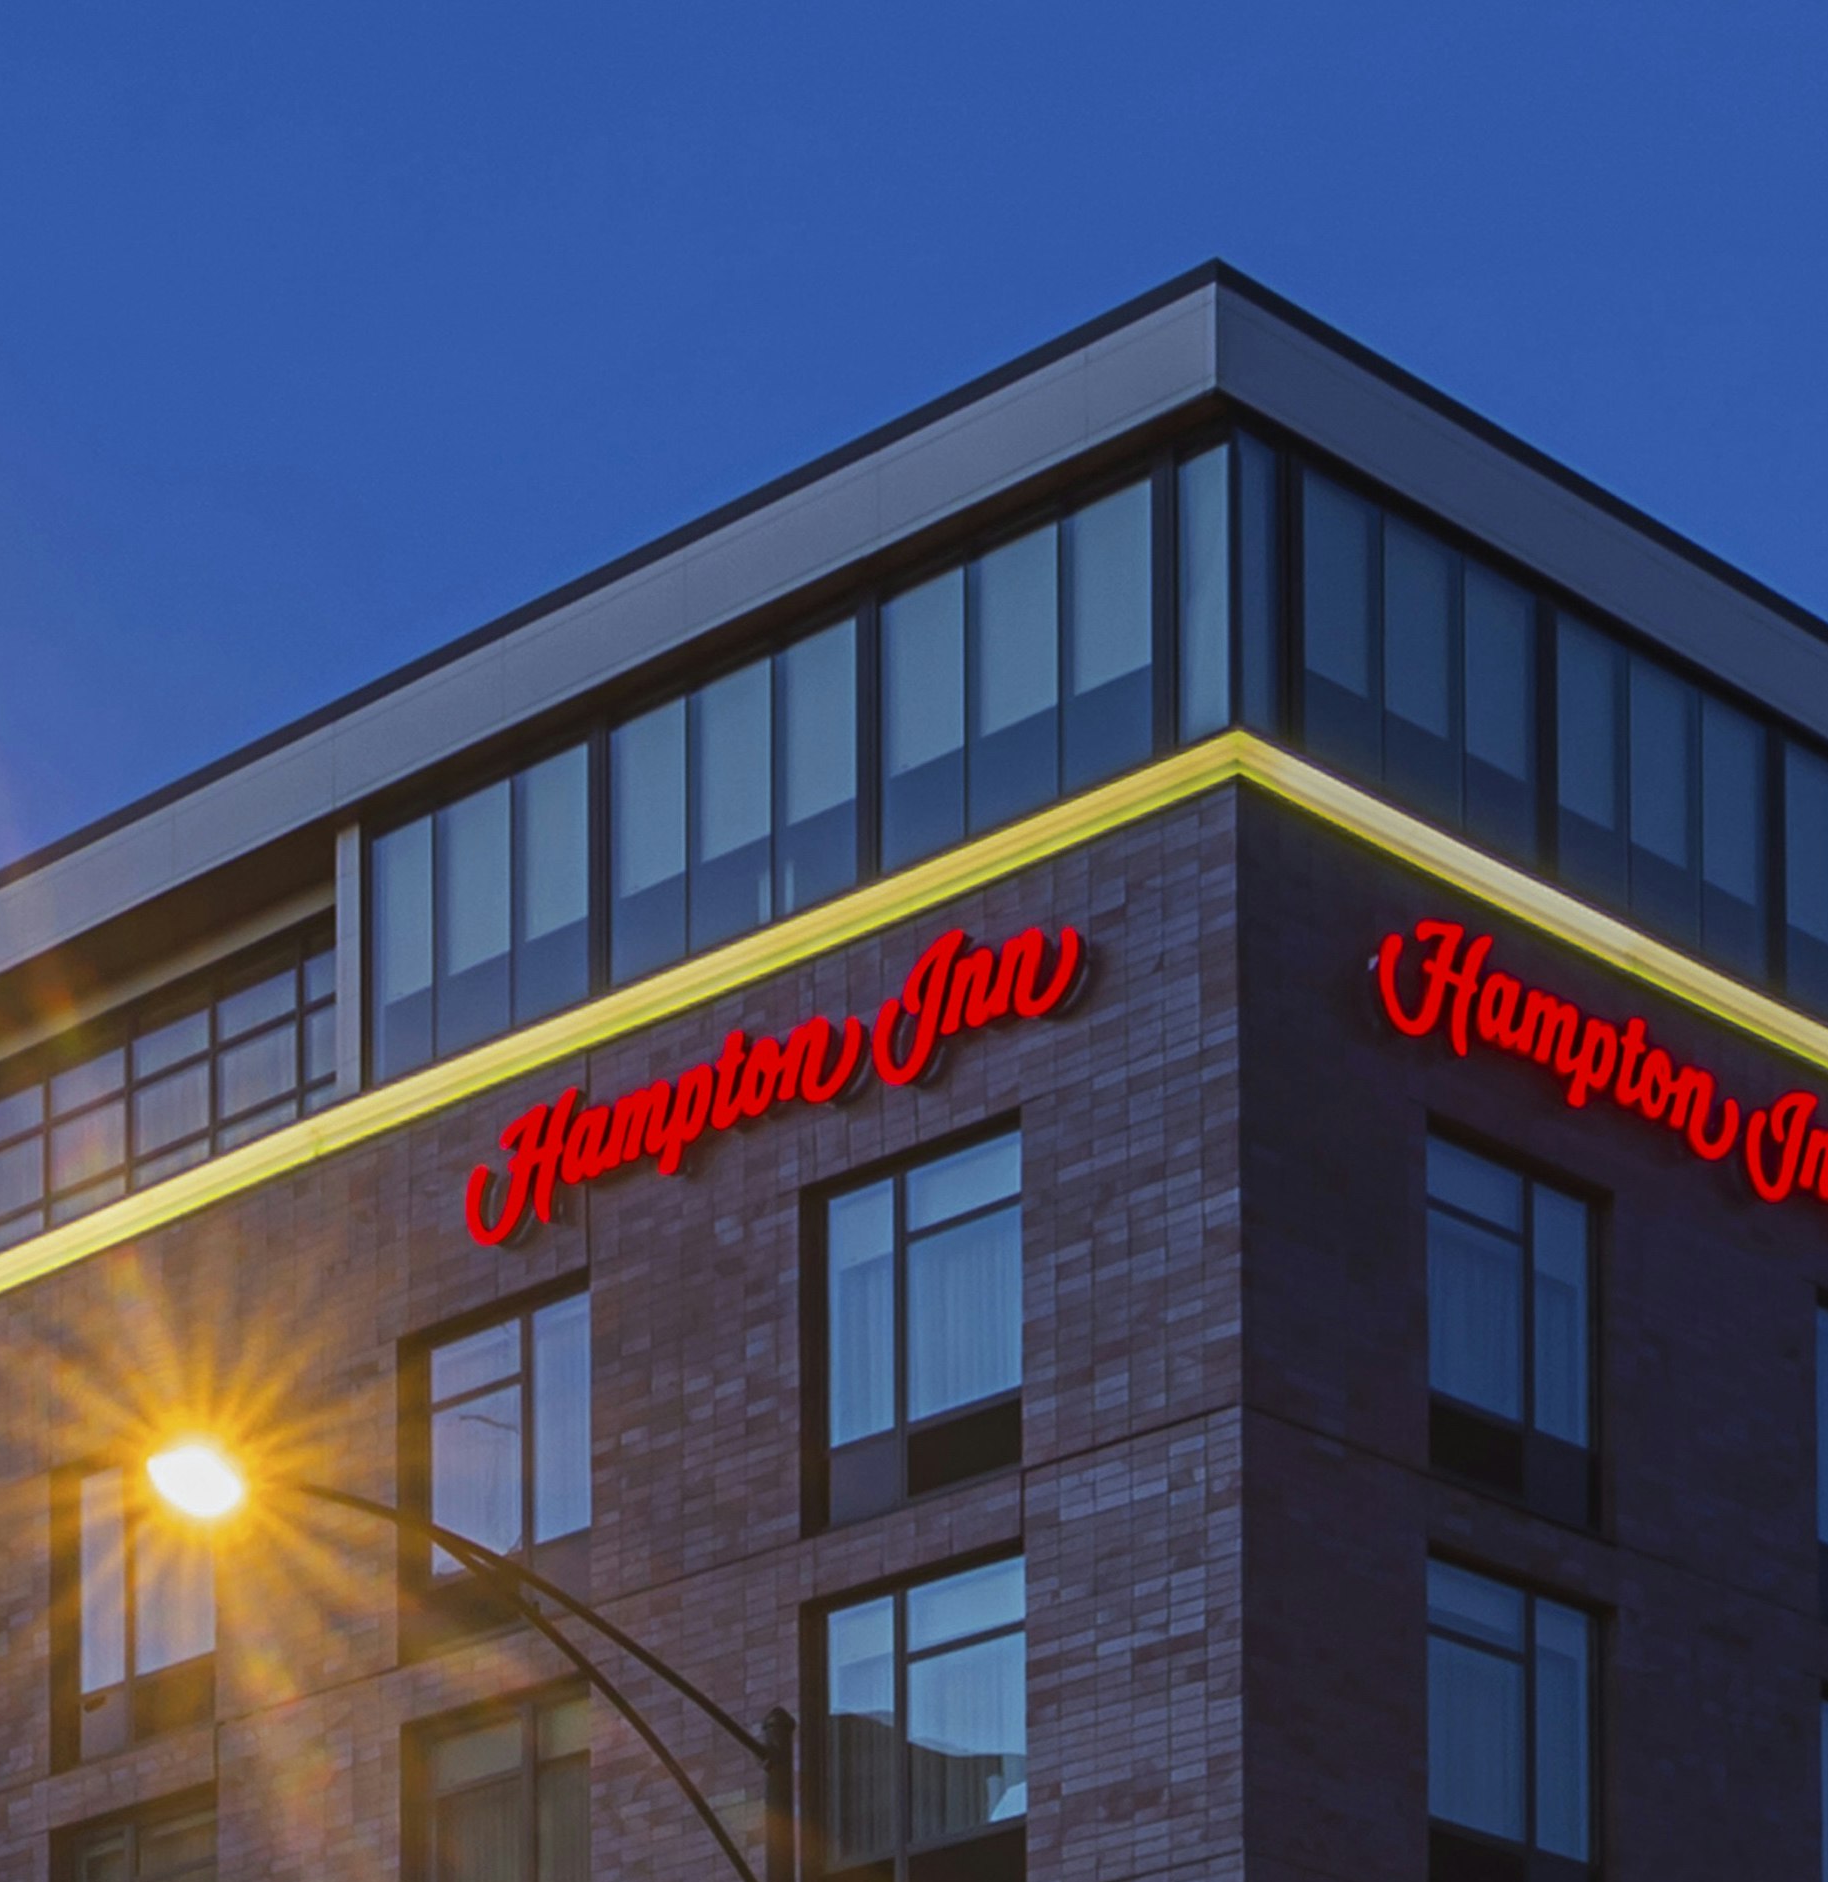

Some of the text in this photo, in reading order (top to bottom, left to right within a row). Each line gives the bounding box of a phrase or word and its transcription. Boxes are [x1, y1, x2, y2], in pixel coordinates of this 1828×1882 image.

[464, 925, 1085, 1248] Hampton Inn
[1377, 918, 1740, 1162] Hampton
